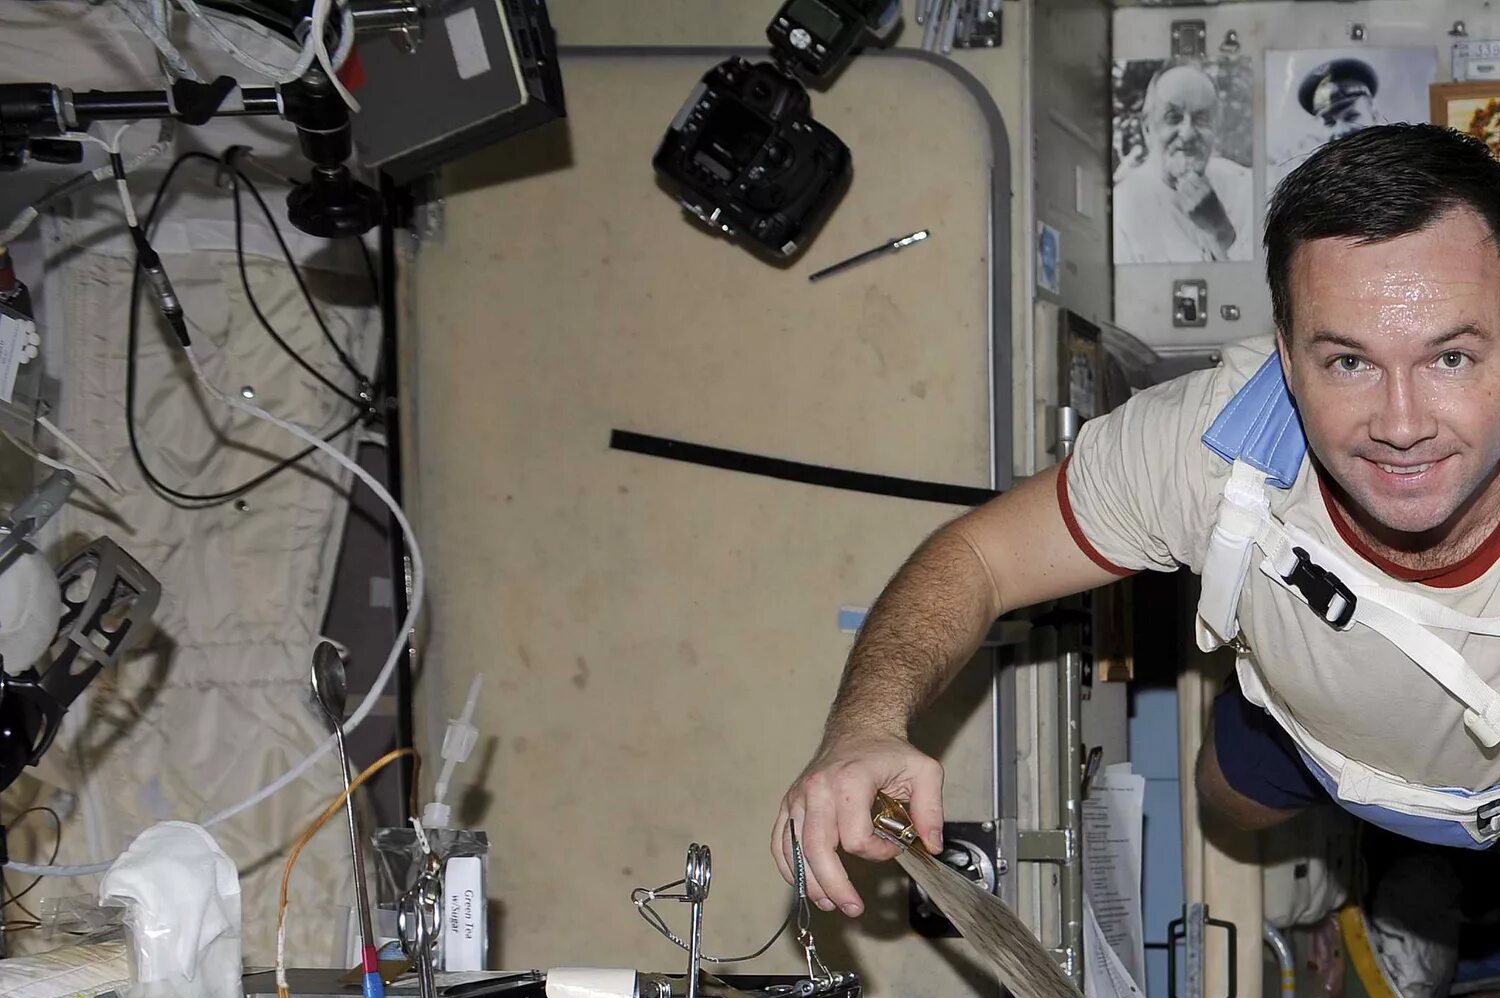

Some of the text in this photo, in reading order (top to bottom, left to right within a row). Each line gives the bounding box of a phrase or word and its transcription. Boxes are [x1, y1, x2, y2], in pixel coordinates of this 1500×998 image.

[449, 895, 460, 933] w/Sugar
[464, 889, 474, 940] Green Tea
